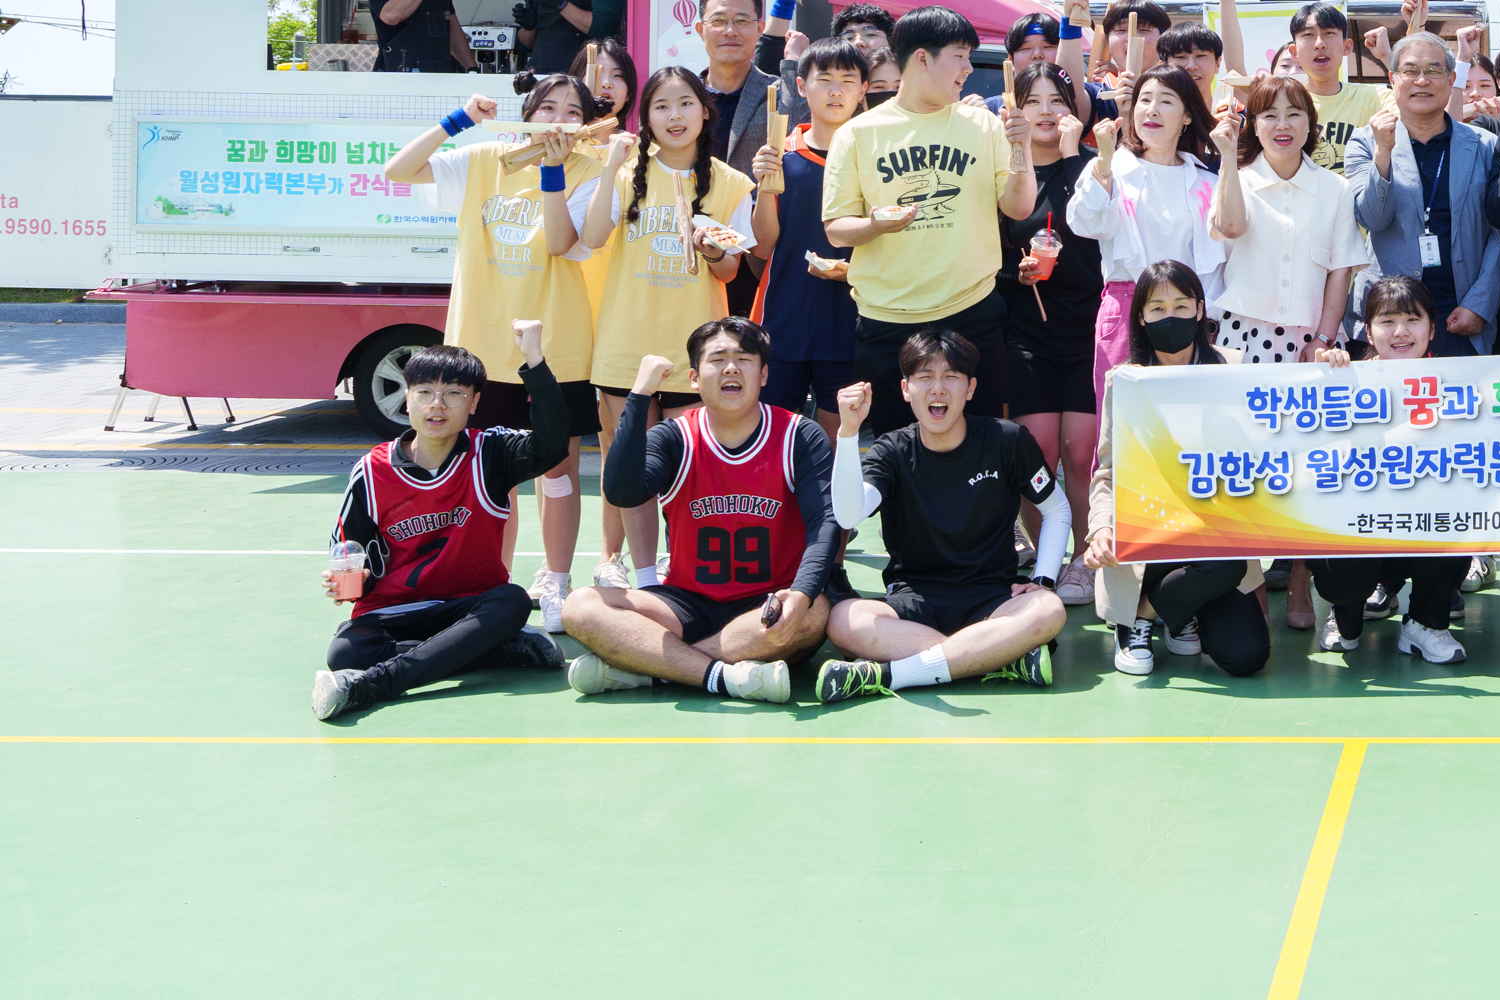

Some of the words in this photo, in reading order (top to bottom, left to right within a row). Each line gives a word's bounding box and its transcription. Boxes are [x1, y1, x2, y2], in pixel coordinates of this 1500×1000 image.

[226, 139, 268, 163] 꿈과
[275, 139, 336, 164] 희망이
[877, 144, 977, 184] SURFIN'
[179, 170, 344, 196] 월성원자력본부가
[499, 225, 529, 242] MUSK
[1246, 386, 1388, 430] 학생들의
[1403, 376, 1479, 426] 꿈과
[1182, 450, 1289, 495] 김한성
[689, 494, 782, 519] SHOHOKU
[404, 537, 450, 589] 7
[695, 526, 771, 585] 99
